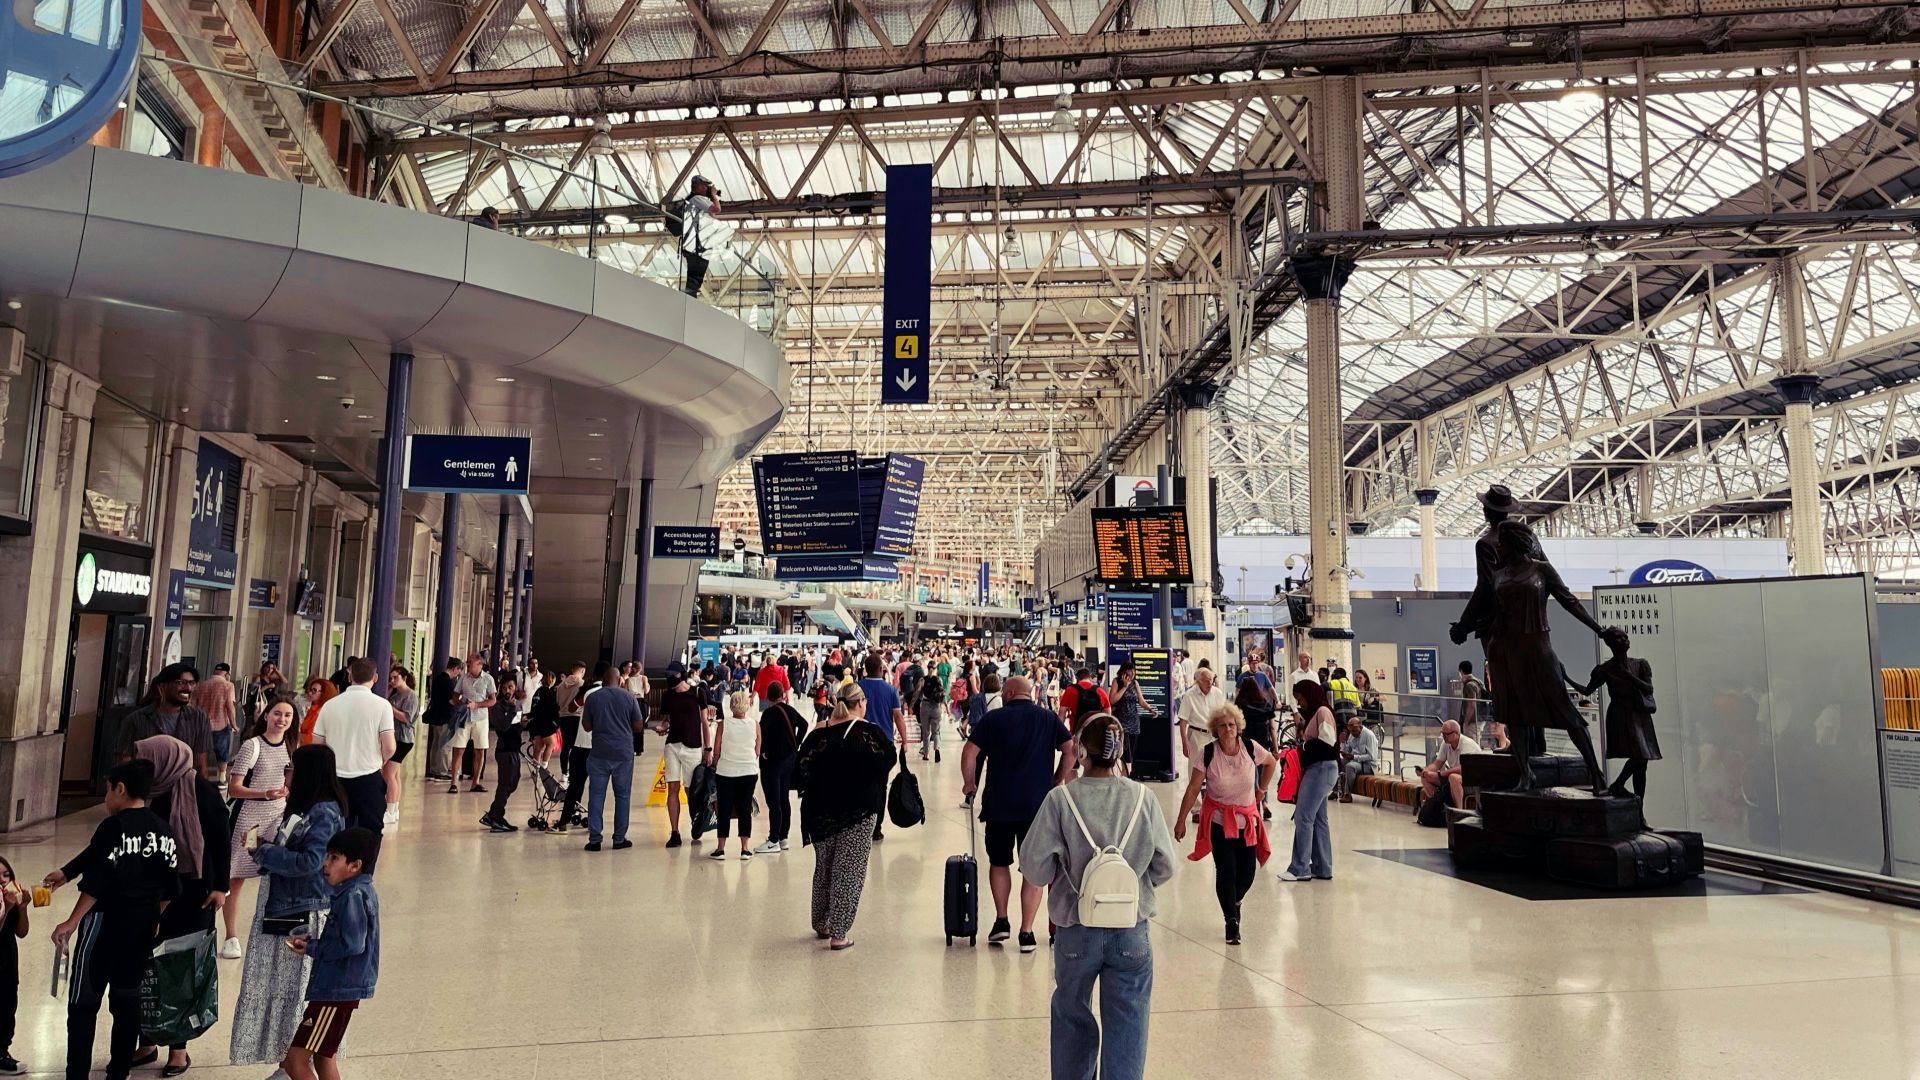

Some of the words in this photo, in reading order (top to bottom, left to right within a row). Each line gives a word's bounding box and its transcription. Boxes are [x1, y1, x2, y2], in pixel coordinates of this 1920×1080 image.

[896, 320, 919, 328] EXIT
[900, 338, 912, 355] 4
[444, 460, 495, 470] Gentlemen
[194, 563, 206, 576] change
[1645, 568, 1704, 583] Boots
[96, 569, 150, 596] STARBUCKS
[1601, 596, 1612, 604] THE
[1615, 594, 1657, 604] NATIONAL
[1601, 610, 1659, 619] WINDRUSH
[1602, 624, 1659, 634] UMENT
